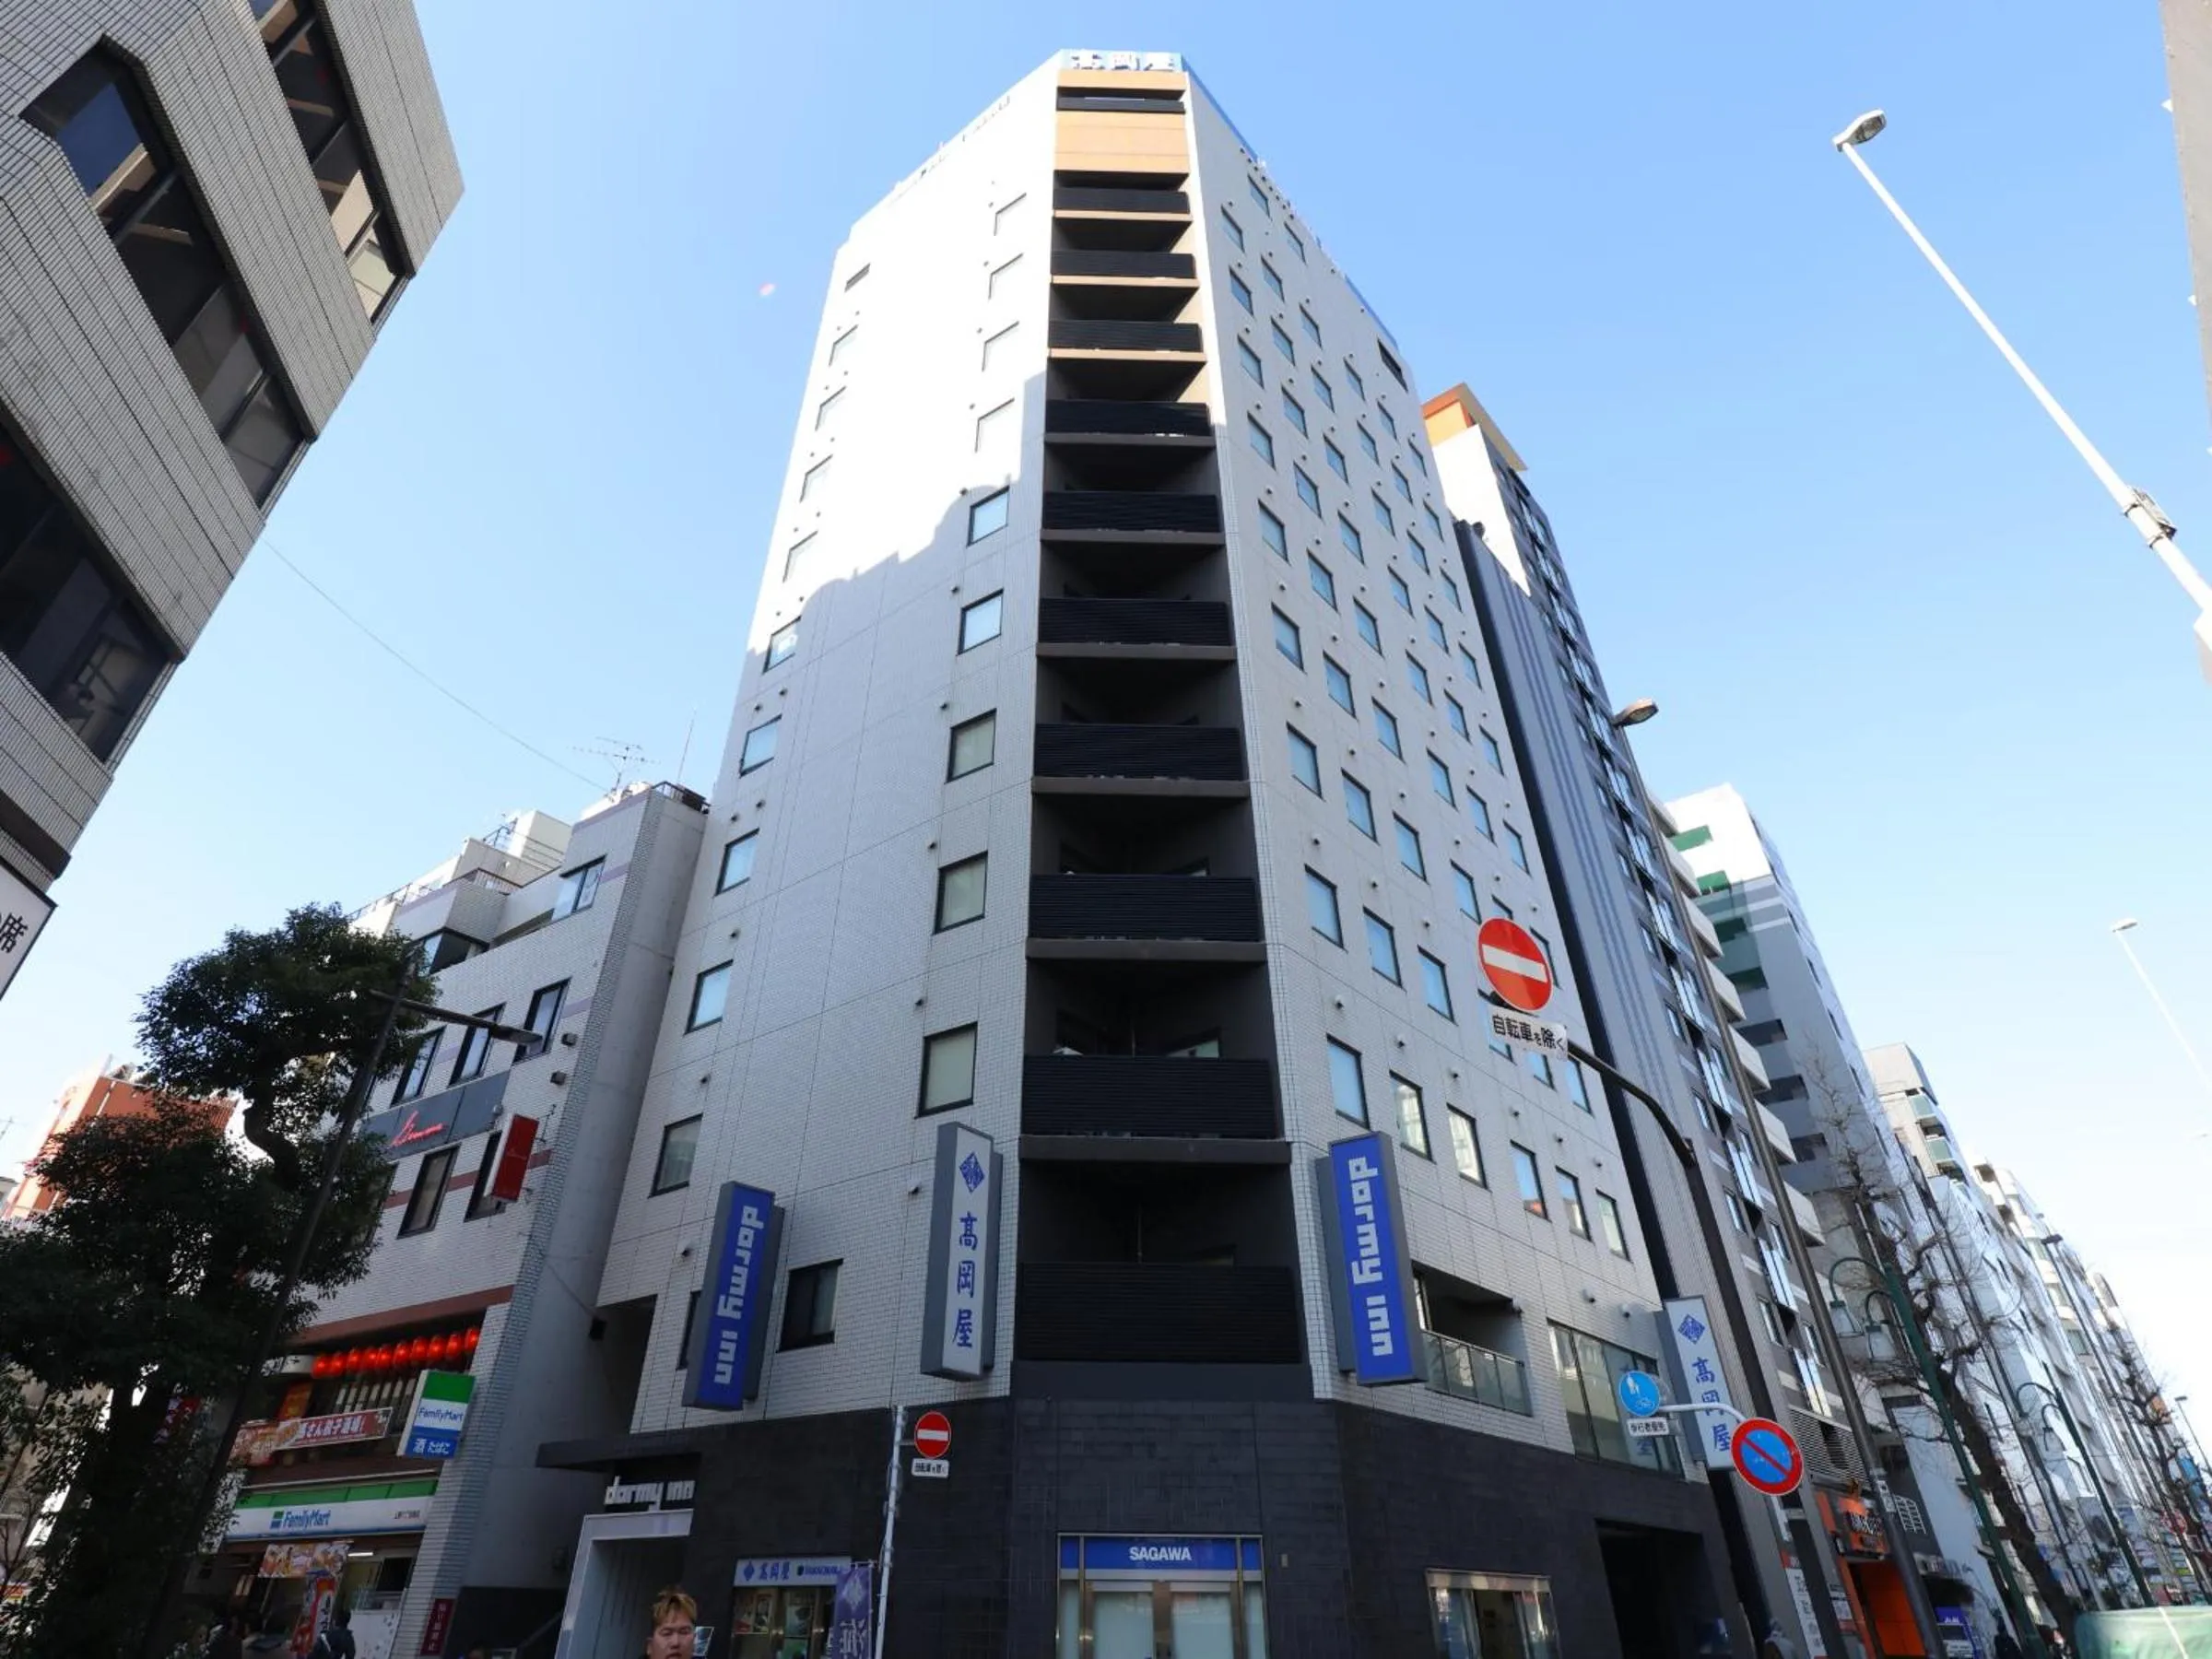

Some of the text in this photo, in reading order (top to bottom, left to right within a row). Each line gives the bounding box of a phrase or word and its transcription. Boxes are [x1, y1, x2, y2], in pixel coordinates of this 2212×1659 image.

[1492, 1014, 1565, 1051] 自転車を除く
[1348, 1157, 1393, 1356] dormy inn
[713, 1206, 764, 1384] dormy inn
[418, 1407, 464, 1422] FamilyMart
[604, 1476, 695, 1512] dormy inn
[283, 1510, 331, 1529] FamilyMart
[1129, 1547, 1192, 1561] SAGAWA
